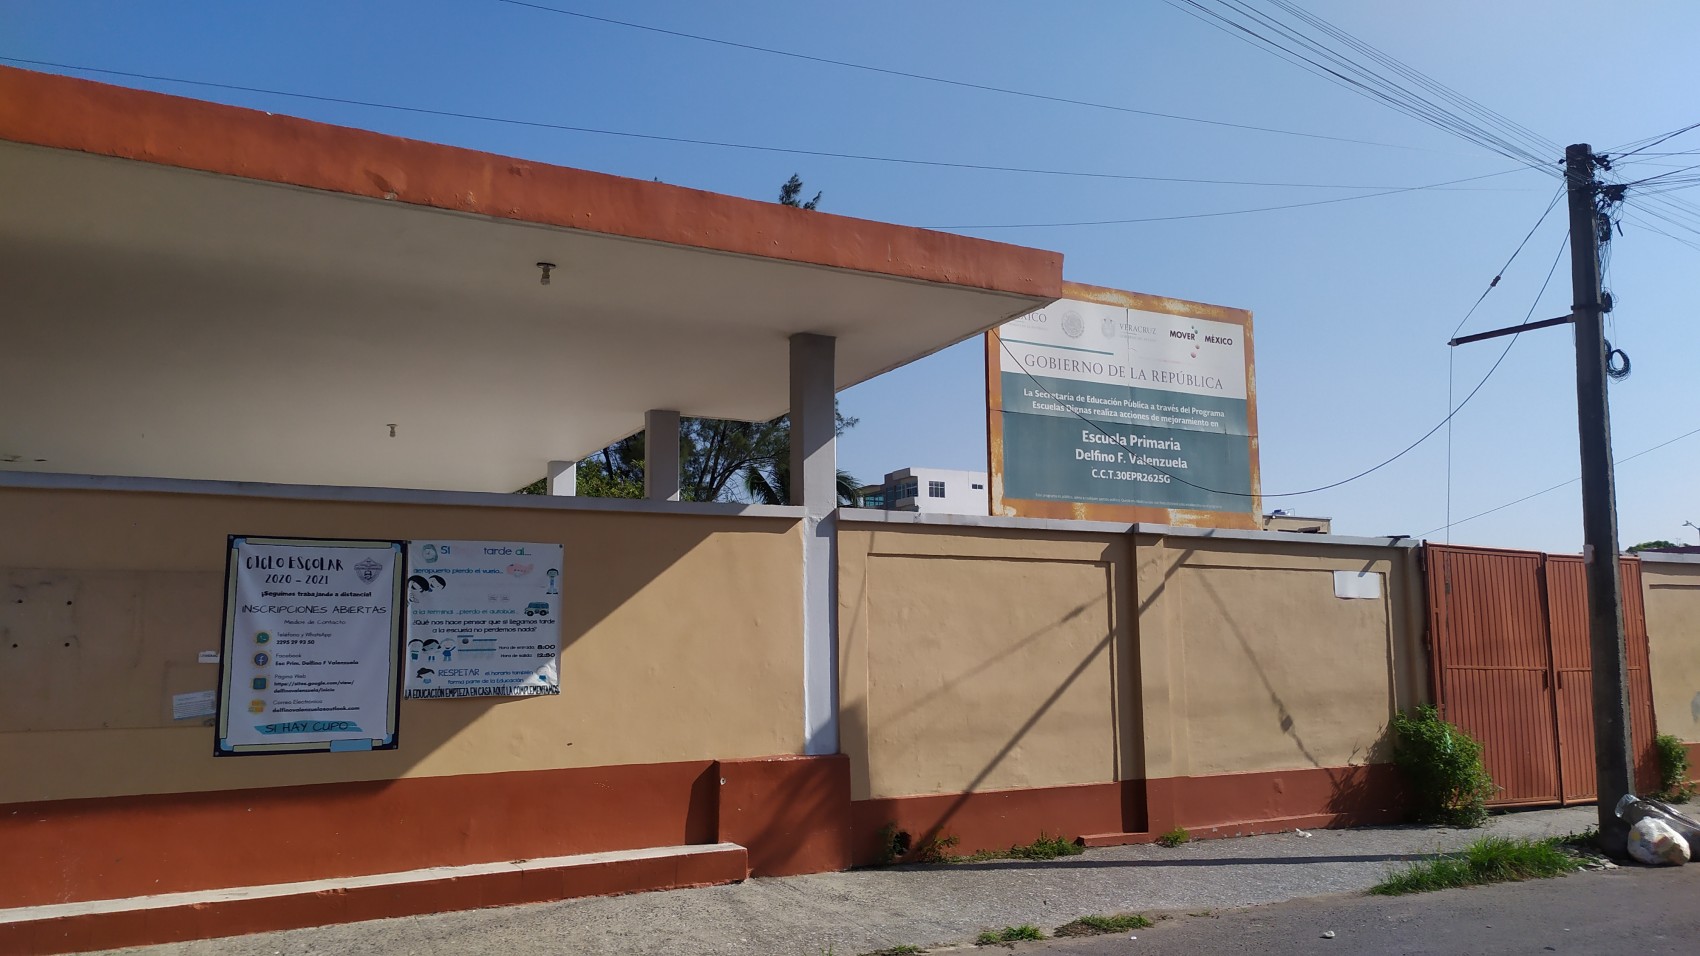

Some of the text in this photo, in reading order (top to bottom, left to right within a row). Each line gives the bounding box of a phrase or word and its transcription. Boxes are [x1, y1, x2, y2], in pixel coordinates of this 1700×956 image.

[1119, 323, 1157, 335] VERACRUZ
[1169, 330, 1196, 340] MOVER
[1204, 334, 1233, 346] MÉXICO
[1024, 353, 1224, 390] GOBIERNO DE LA REPÚBLICA
[1024, 388, 1033, 396] La
[1076, 394, 1086, 402] de
[1086, 396, 1122, 406] Educación
[1124, 398, 1149, 410] Pública
[1156, 404, 1179, 412] través
[1192, 407, 1224, 417] Programa
[1032, 401, 1064, 412] Escuelas
[1066, 404, 1092, 414] Dignas
[1094, 408, 1118, 417] realiza
[1120, 411, 1149, 420] acciones
[1161, 416, 1209, 427] mejoramiento
[1082, 430, 1181, 451] Escuela Primaria
[1075, 448, 1188, 469] Delfino F. Valenzuela
[1091, 468, 1171, 483] C.C.T.30EPR2625G
[484, 547, 512, 555] tarde
[246, 555, 284, 570] CICLO
[288, 556, 344, 572] ESCOLAR
[265, 574, 292, 584] 2020
[305, 574, 329, 584] 2021
[242, 605, 387, 614] INSCRIPCIONES ABIERTAS
[405, 689, 411, 699] LA
[413, 686, 444, 698] EDUCACIÓN
[446, 688, 469, 697] EMPIEZA
[470, 687, 478, 696] EN
[478, 686, 492, 696] CASA
[493, 684, 505, 695] AQUÍ
[506, 686, 512, 695] LA
[265, 722, 349, 733] SI HAY CUPO
